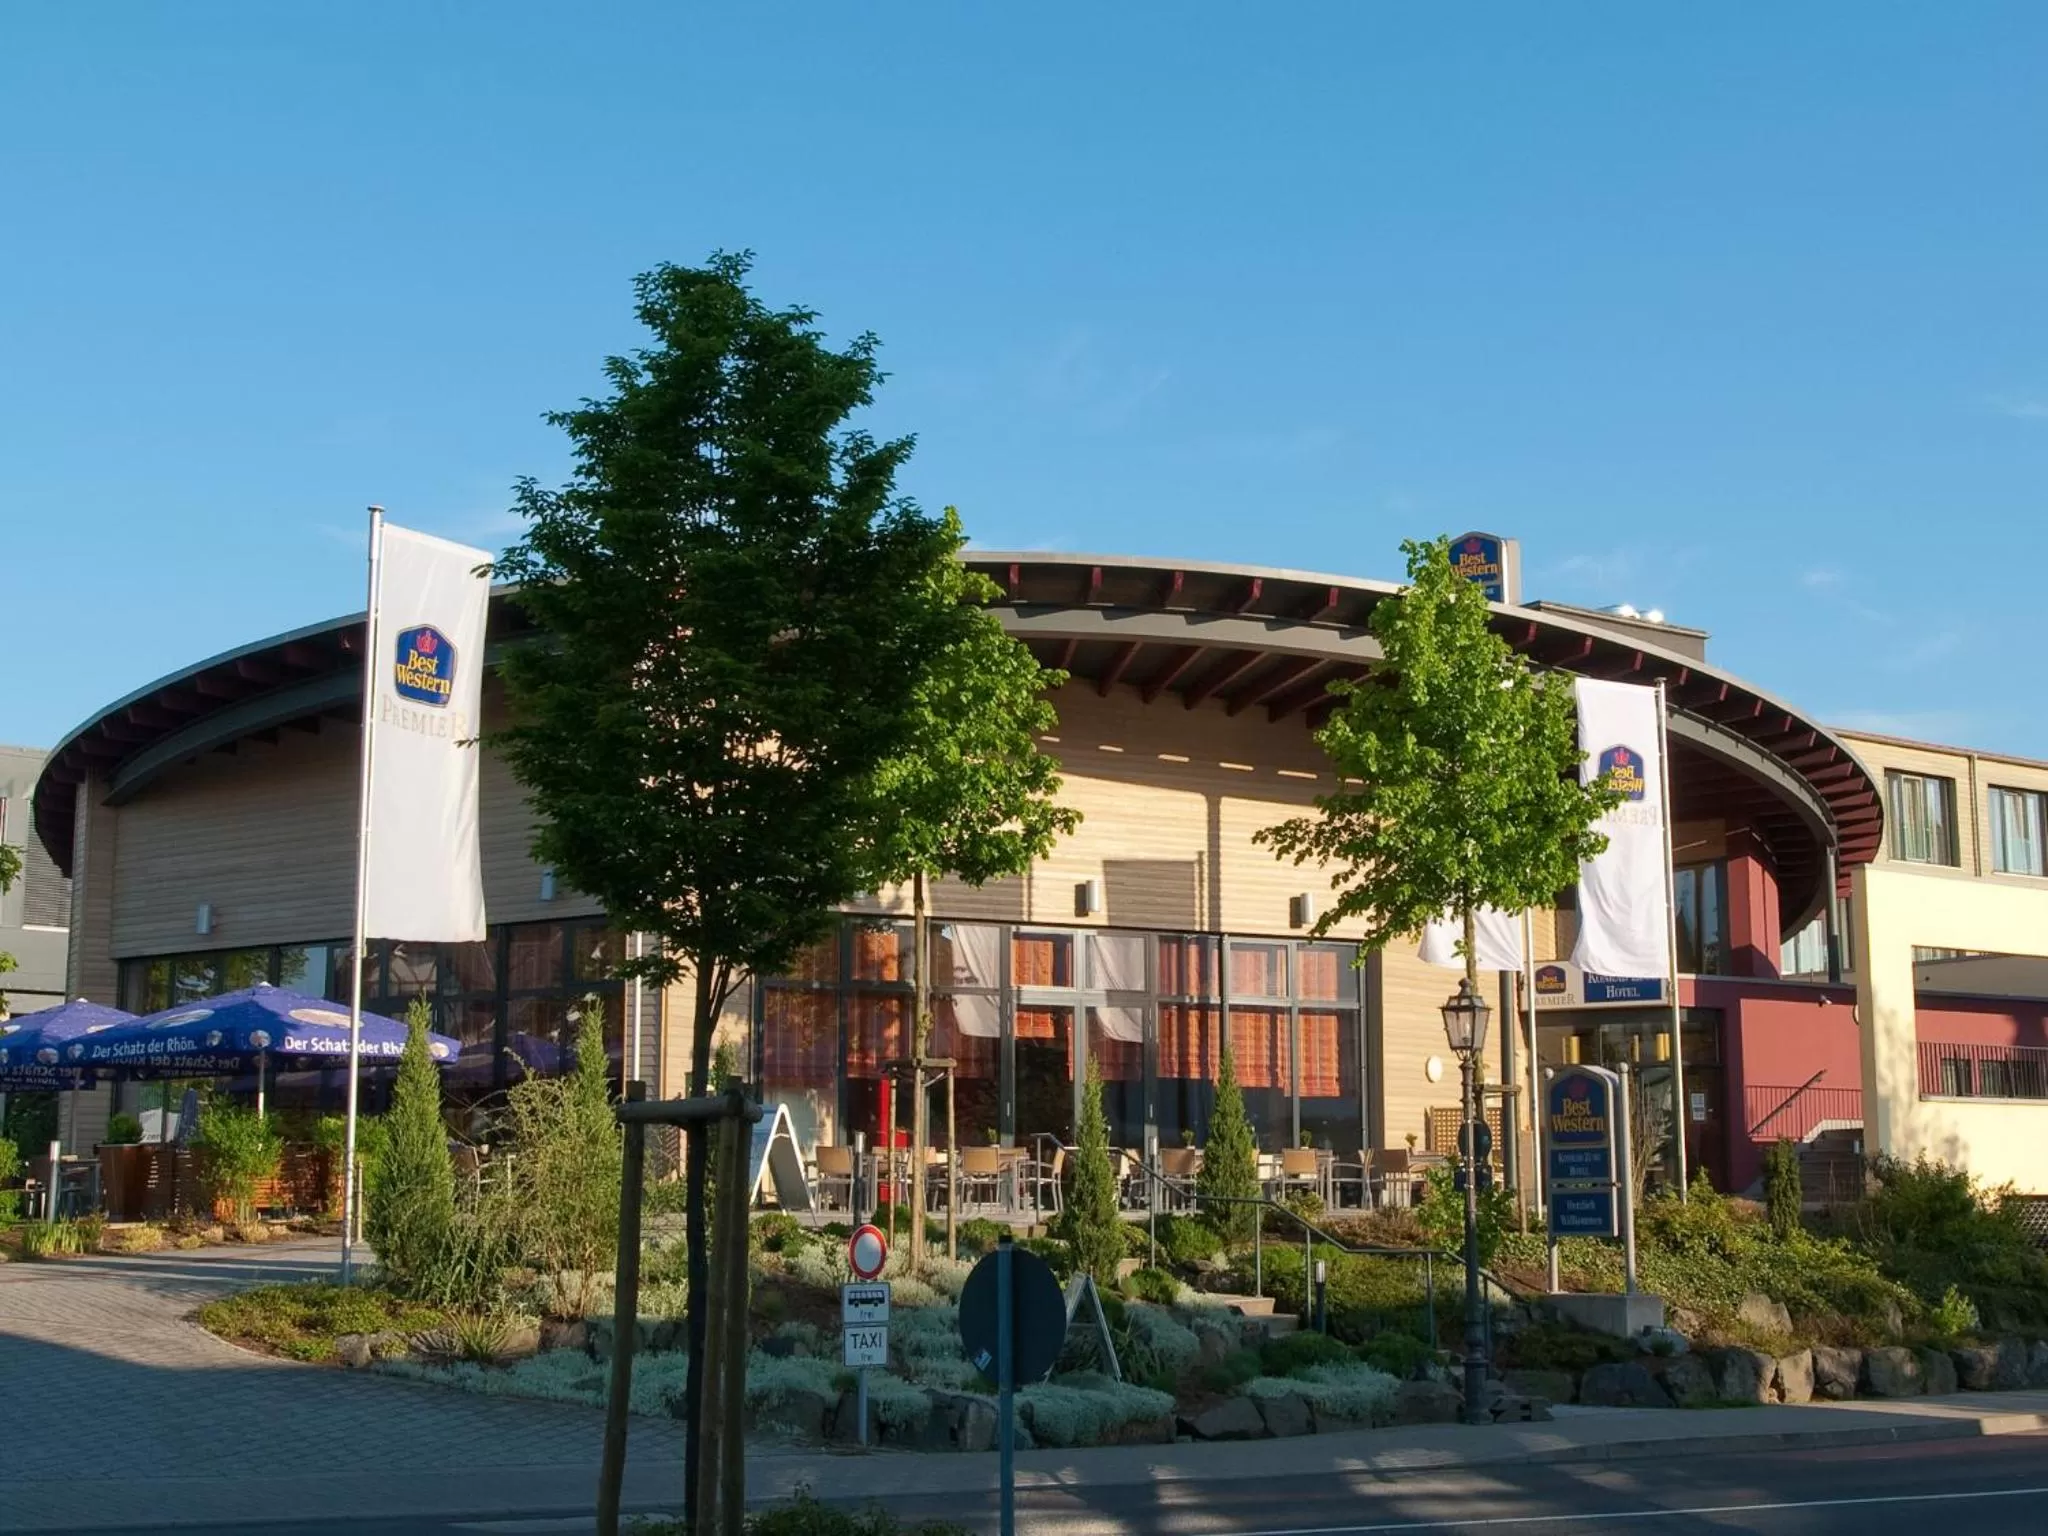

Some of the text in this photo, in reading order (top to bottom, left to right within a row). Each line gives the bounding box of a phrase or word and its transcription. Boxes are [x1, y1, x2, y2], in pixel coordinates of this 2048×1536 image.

[1459, 552, 1485, 565] Best
[408, 649, 439, 674] Best
[394, 663, 450, 695] Western
[1606, 985, 1641, 999] HOTEL
[92, 1036, 198, 1058] Der Schatz der Rhön.
[284, 1036, 308, 1051] Der
[311, 1037, 351, 1052] Schat
[358, 1040, 379, 1054] der
[1563, 1098, 1591, 1116] Best
[1551, 1115, 1604, 1132] Western
[850, 1332, 882, 1349] TAXI
